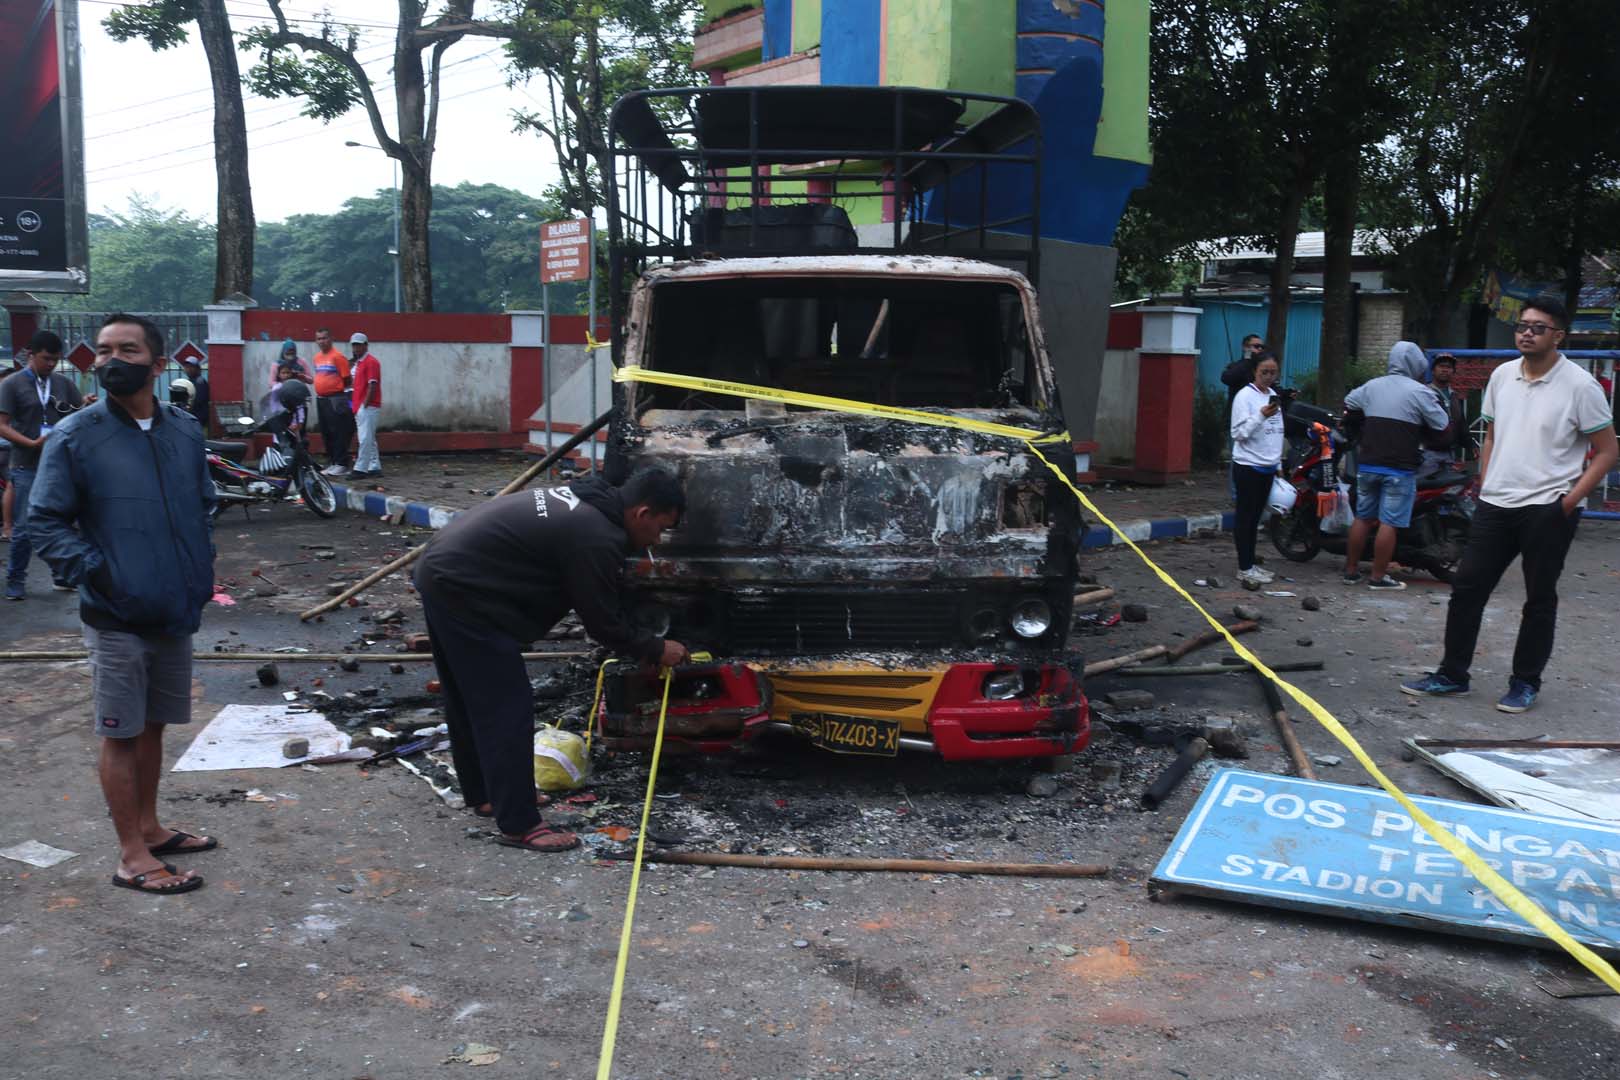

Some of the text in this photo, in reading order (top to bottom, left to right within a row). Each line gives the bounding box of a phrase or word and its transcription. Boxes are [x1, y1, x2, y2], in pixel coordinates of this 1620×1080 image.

[534, 488, 548, 517] SECRET
[1221, 784, 1347, 829] POS
[1221, 854, 1444, 906] STADION
